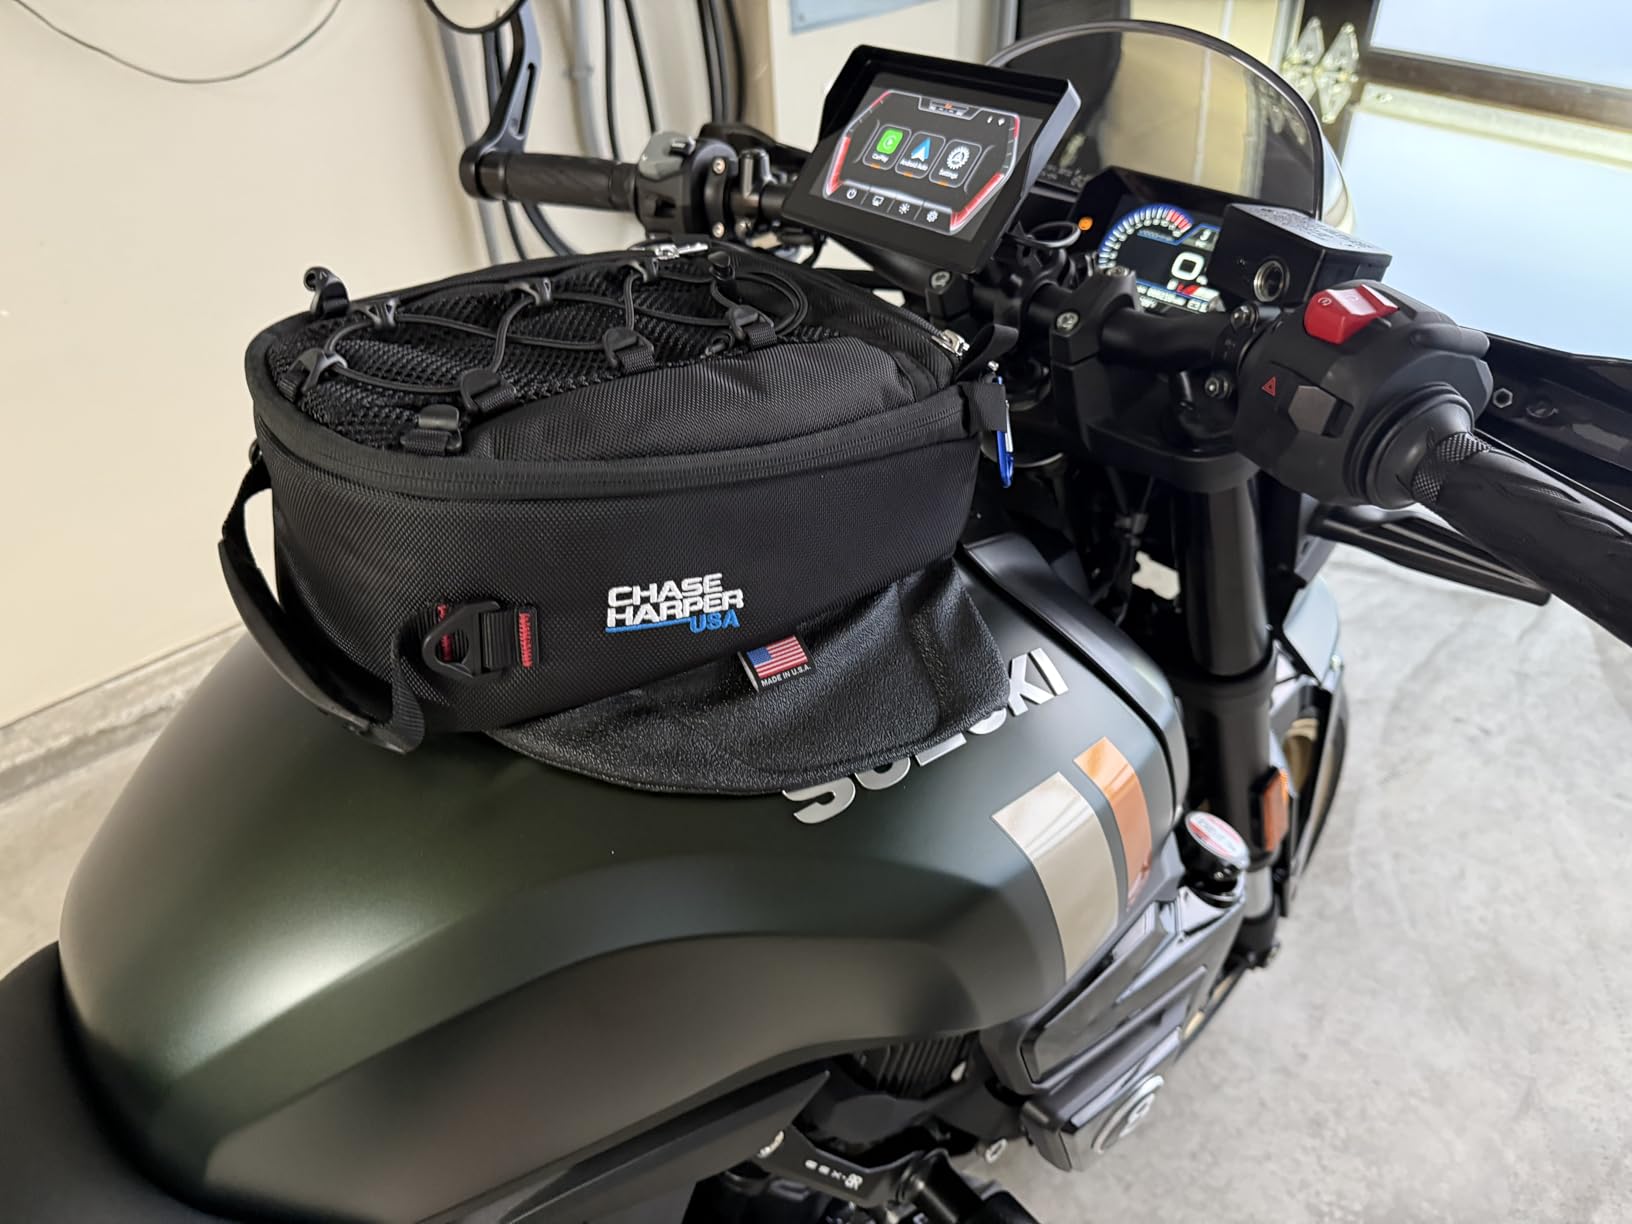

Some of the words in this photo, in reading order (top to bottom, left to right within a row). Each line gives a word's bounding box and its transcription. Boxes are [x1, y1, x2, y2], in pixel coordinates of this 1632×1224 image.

[1171, 251, 1205, 281] 0
[607, 573, 722, 607] CHASE
[606, 588, 744, 627] HARPER
[689, 609, 740, 633] USA
[761, 673, 782, 687] MADE
[782, 671, 791, 679] IN
[782, 648, 1069, 824] SKI
